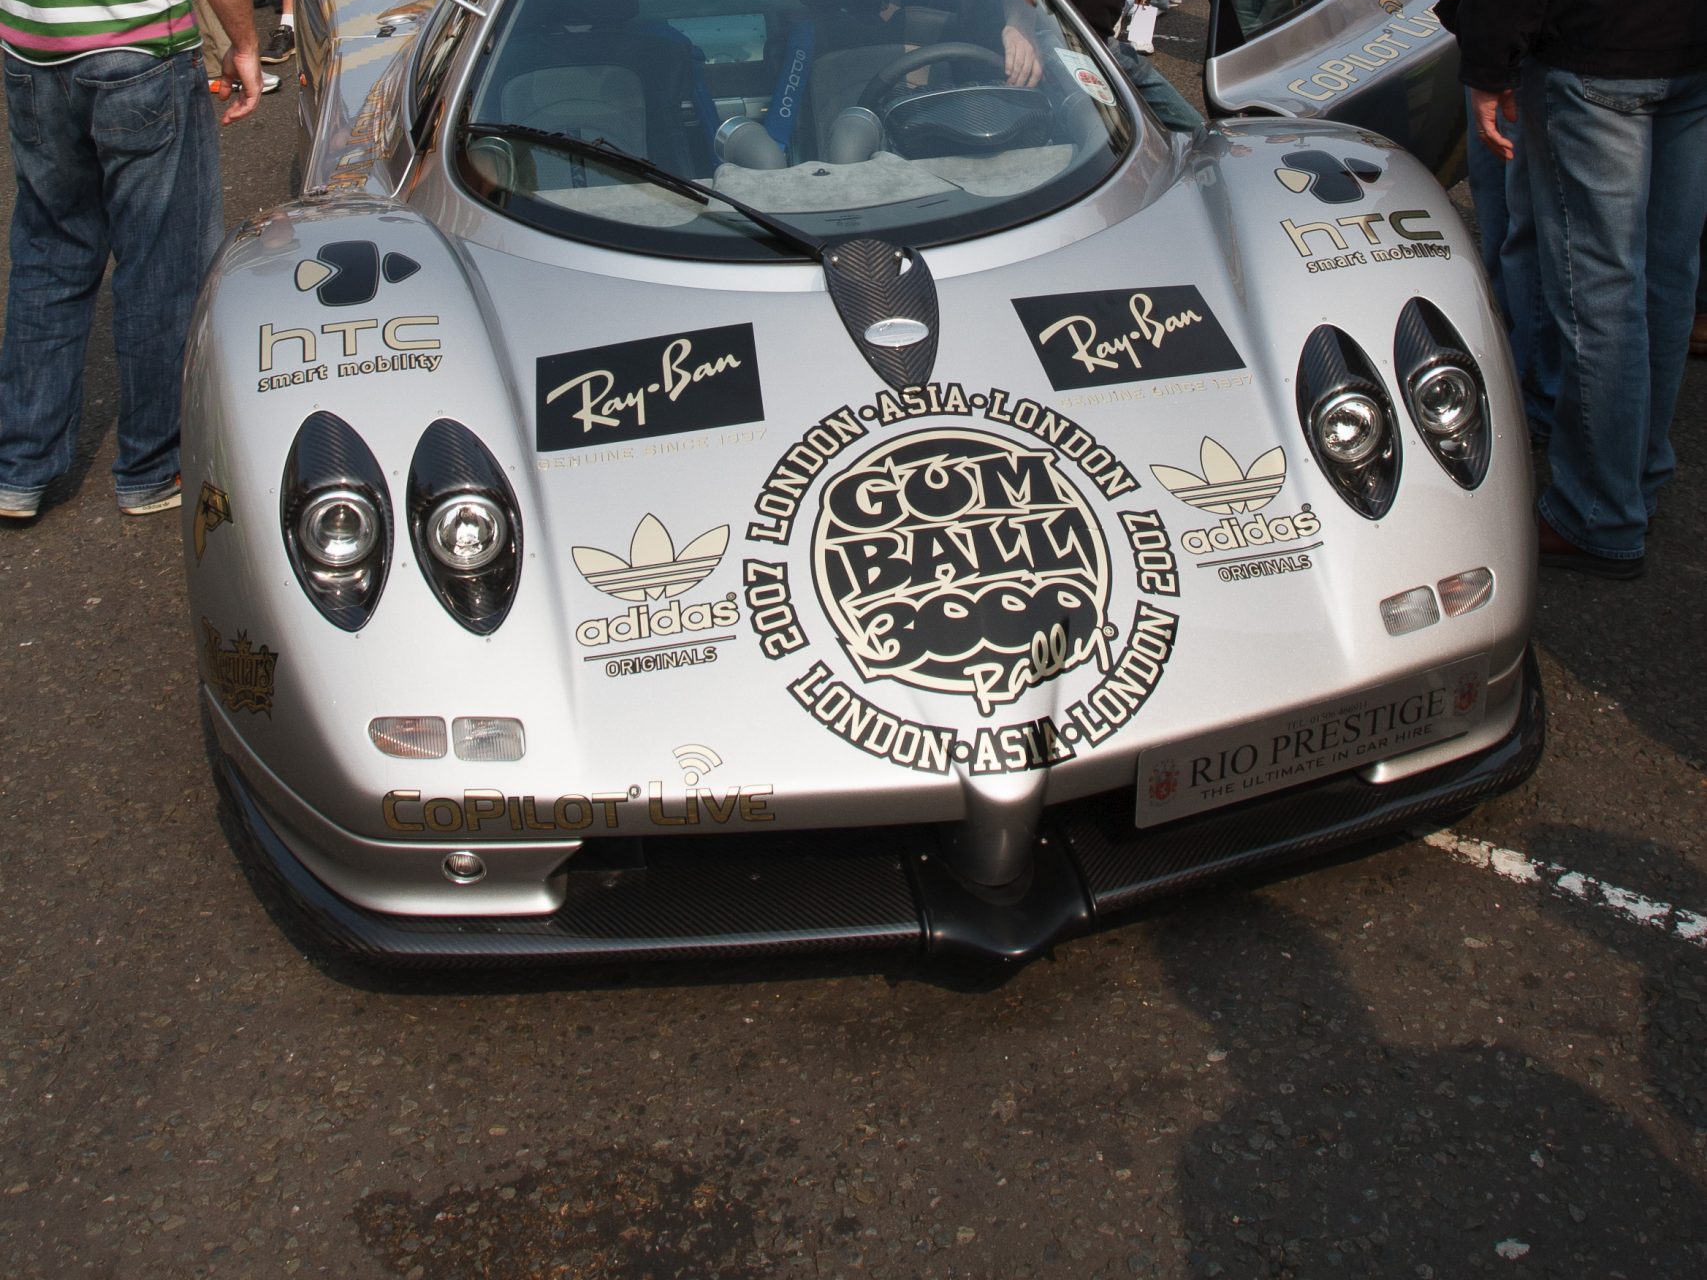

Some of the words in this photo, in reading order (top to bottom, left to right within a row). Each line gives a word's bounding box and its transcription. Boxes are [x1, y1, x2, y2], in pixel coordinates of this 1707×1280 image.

[1306, 251, 1367, 273] smart
[1372, 243, 1451, 266] mobility
[258, 365, 329, 393] smart
[338, 353, 443, 378] mobility
[874, 383, 971, 427] ASIA
[745, 402, 869, 546] LONDON
[985, 388, 1141, 501] LONDON
[827, 454, 1066, 531] GUM
[1180, 511, 1322, 555] adidas
[838, 510, 1099, 594] BALL
[1117, 510, 1180, 597] 2007
[1218, 555, 1312, 583] ORIGINALS
[576, 593, 741, 646] adidas
[743, 559, 811, 660] 2007
[846, 581, 1100, 673] 3000
[606, 647, 717, 678] ORIGINALS
[962, 622, 1112, 715] Rally
[1067, 599, 1179, 747] LONDON
[787, 660, 958, 774] LONDON
[969, 716, 1076, 776] ASIA
[1189, 744, 1258, 789] RIO
[1270, 687, 1447, 765] PRESTIGE
[1201, 783, 1235, 801] THE
[1243, 757, 1327, 789] ULTIMATE
[1332, 748, 1349, 763] IN
[1356, 738, 1388, 756] CAR
[1395, 723, 1434, 744] HIRE
